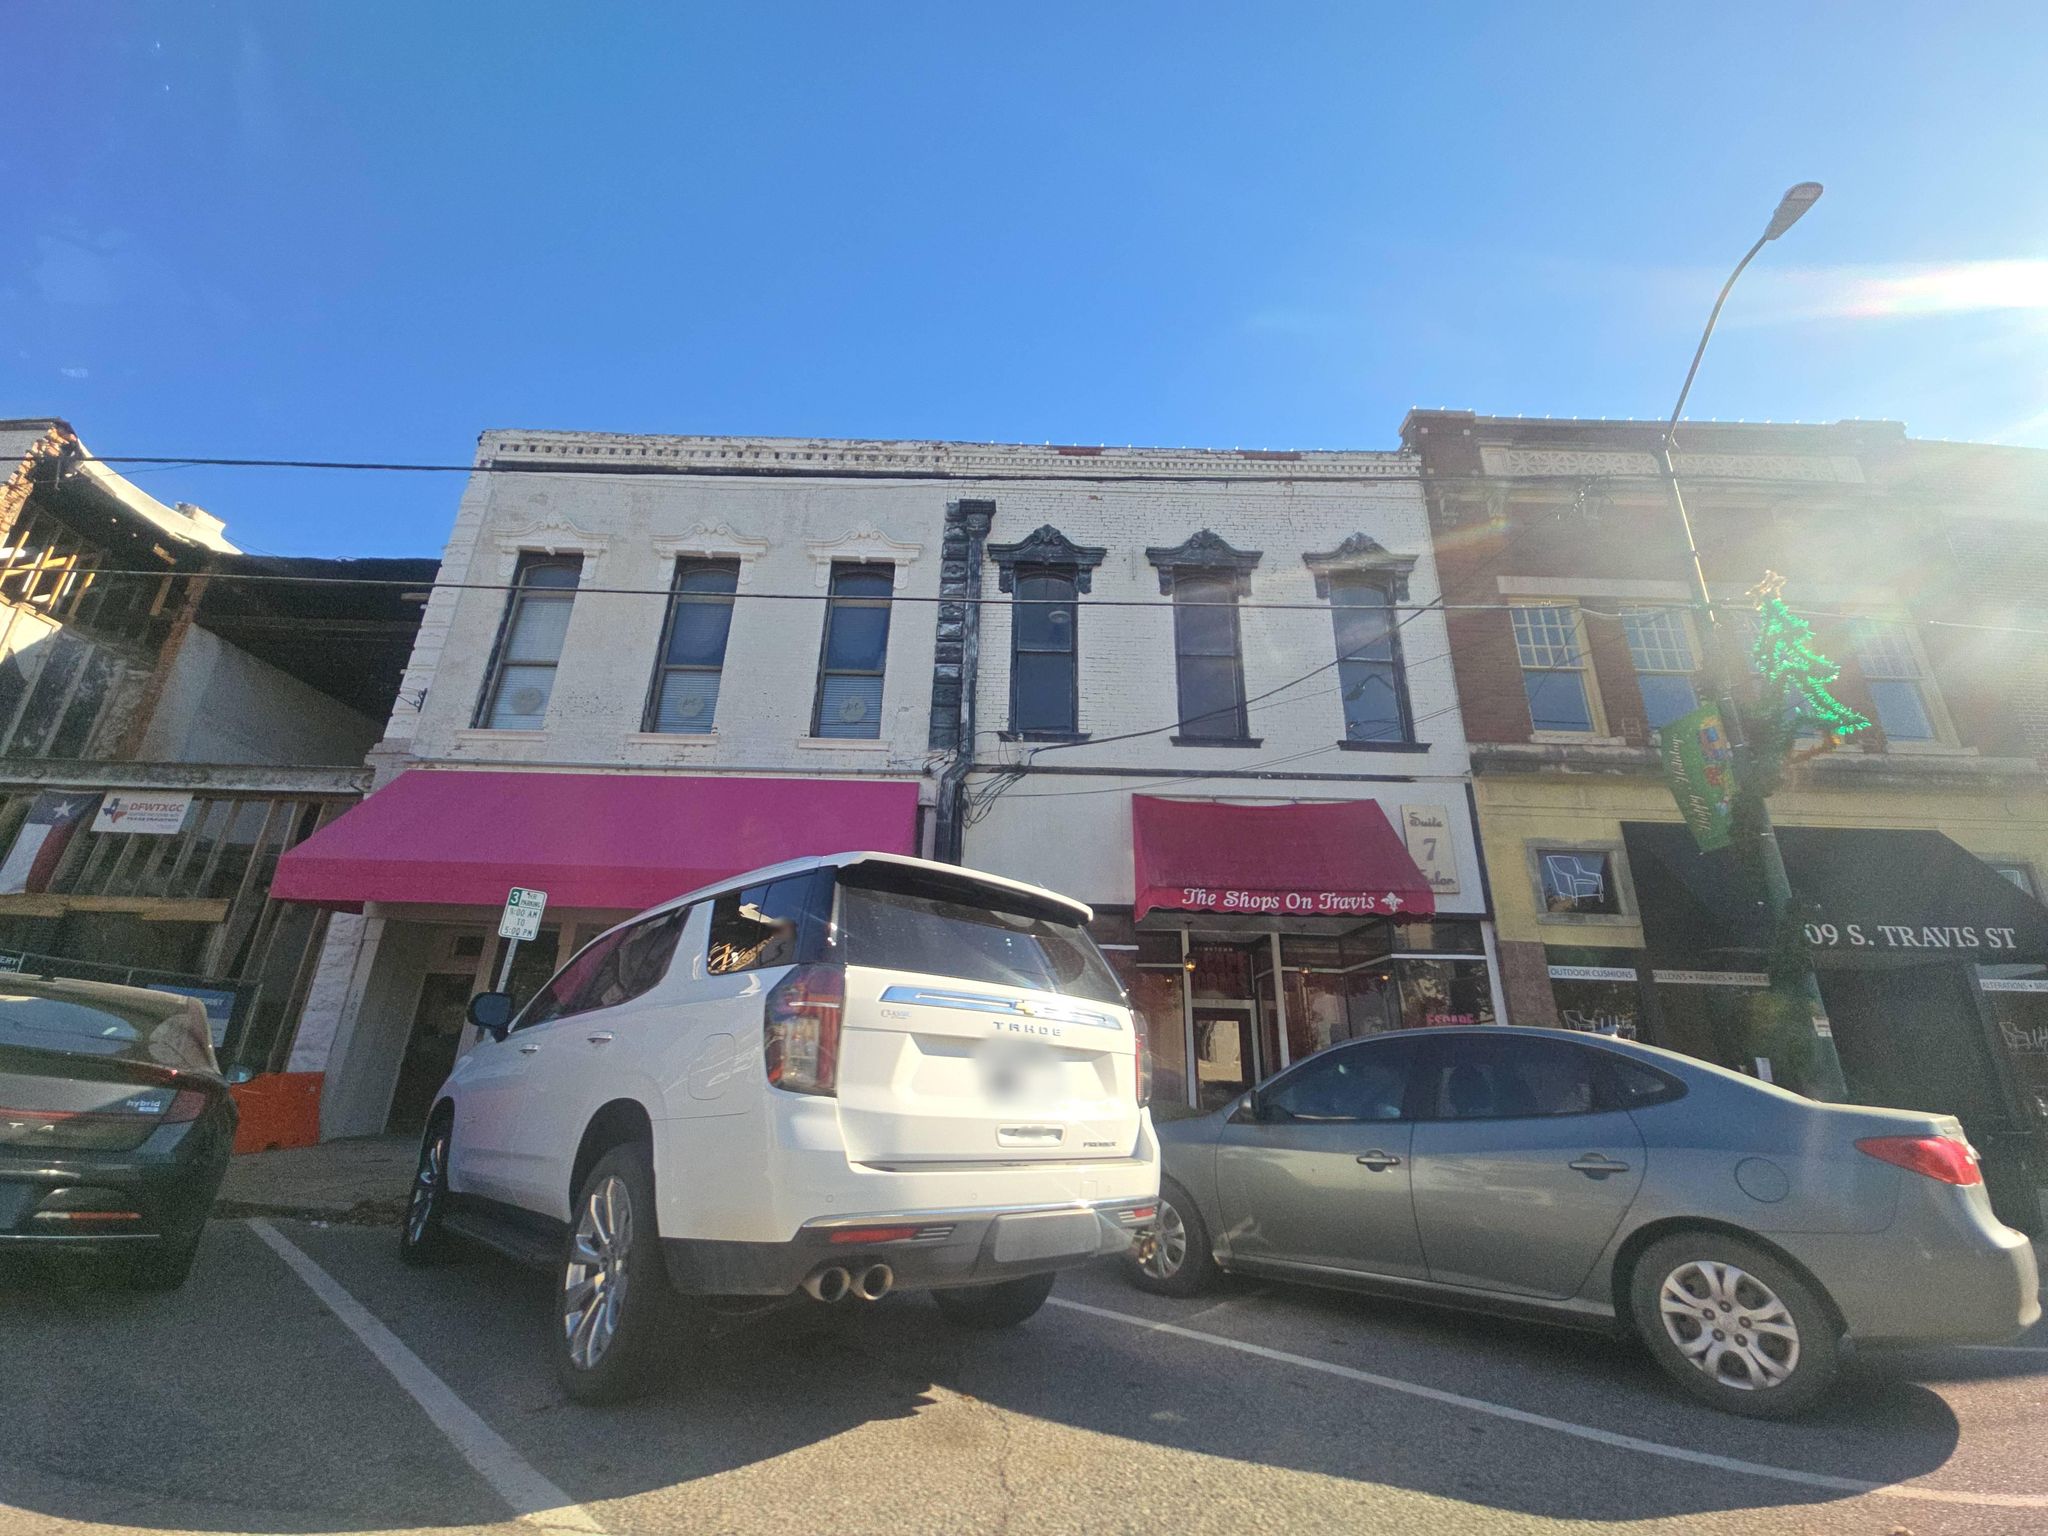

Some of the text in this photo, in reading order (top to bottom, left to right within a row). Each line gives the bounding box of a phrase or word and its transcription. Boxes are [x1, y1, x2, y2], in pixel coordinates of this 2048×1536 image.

[129, 802, 185, 812] DFWTXGC
[1409, 812, 1443, 828] Suite
[1423, 837, 1437, 861] 7
[510, 891, 520, 904] 3
[1182, 887, 1376, 912] The Shops On Travis
[527, 911, 538, 919] AM
[517, 918, 526, 927] TO
[522, 929, 533, 937] PM
[1804, 923, 2018, 949] 09 S. TRAVIS ST
[1550, 968, 1633, 979] OUTDOOR CUSHIONS
[993, 1021, 1061, 1037] TAHOE
[126, 1100, 161, 1108] hybrid
